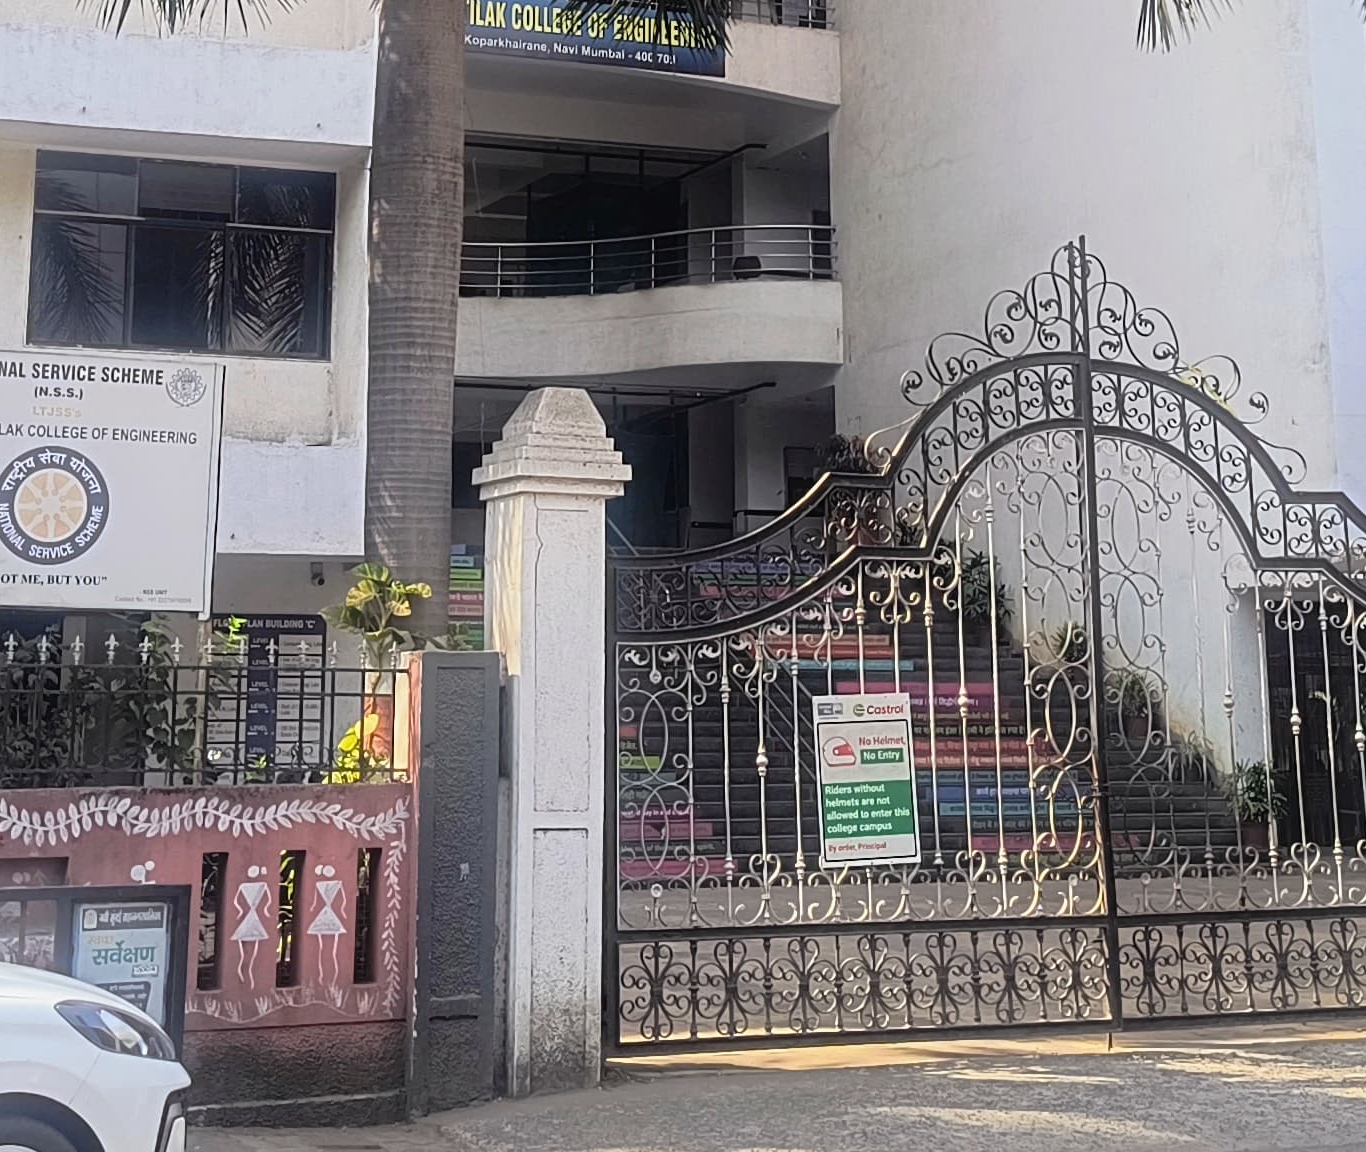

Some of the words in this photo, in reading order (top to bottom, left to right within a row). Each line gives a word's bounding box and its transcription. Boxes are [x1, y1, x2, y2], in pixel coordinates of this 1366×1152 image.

[467, 0, 506, 28] ILAK
[512, 3, 582, 36] COLLEGE
[554, 42, 578, 55] Navi
[581, 46, 625, 60] Mumbai
[31, 363, 96, 382] SERVICE
[101, 366, 164, 385] SCHEME
[34, 386, 84, 400] (N.S.S.)
[27, 424, 88, 439] COLLEGE
[91, 427, 109, 440] OF
[112, 428, 197, 445] ENGINEERING
[37, 448, 67, 465] सेवा
[69, 458, 102, 494] योजना
[28, 542, 75, 559] SERVICE
[74, 505, 104, 547] SCHEME
[21, 574, 44, 587] ME,
[47, 575, 72, 586] BUT
[74, 575, 107, 587] YOU"
[265, 619, 304, 628] BUILDING
[866, 703, 904, 715] Castrol
[858, 736, 871, 746] No
[863, 751, 876, 760] No
[877, 750, 900, 762] Entry
[825, 785, 852, 794] Riders
[854, 783, 885, 793] without
[825, 797, 860, 807] helmets
[876, 796, 891, 805] not
[826, 810, 859, 820] allowed
[860, 809, 869, 818] to
[870, 809, 893, 817] enter
[894, 807, 910, 817] this
[827, 823, 858, 834] college
[859, 822, 893, 833] campus
[92, 940, 156, 965] सर्वेक्षण
